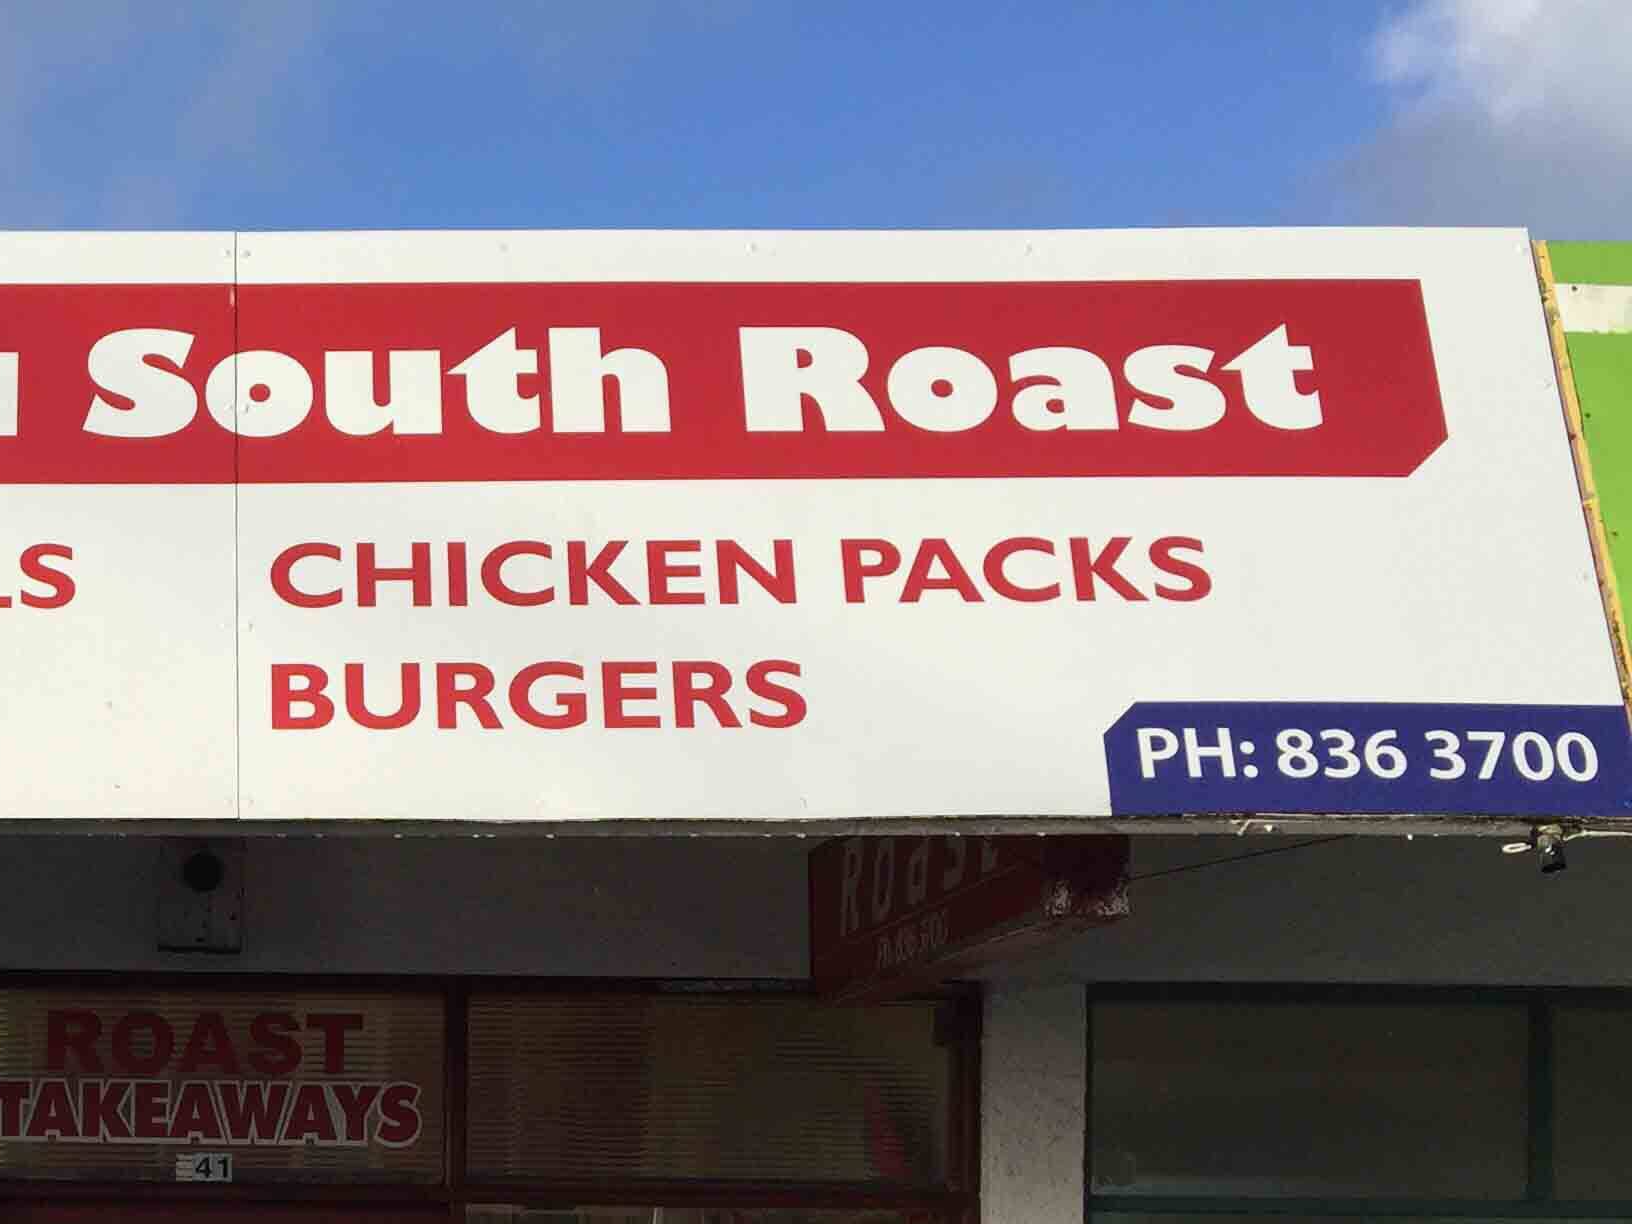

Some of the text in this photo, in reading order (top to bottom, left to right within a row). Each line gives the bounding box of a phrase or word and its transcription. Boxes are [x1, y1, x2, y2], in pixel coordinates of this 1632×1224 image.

[81, 326, 672, 437] South
[737, 323, 1323, 433] Roast
[270, 536, 1213, 608] CHICKEN PACKS
[271, 659, 808, 731] BURGERS
[1135, 726, 1599, 783] PH: 836 3700
[45, 1009, 364, 1077] ROAST
[195, 1157, 232, 1179] 41
